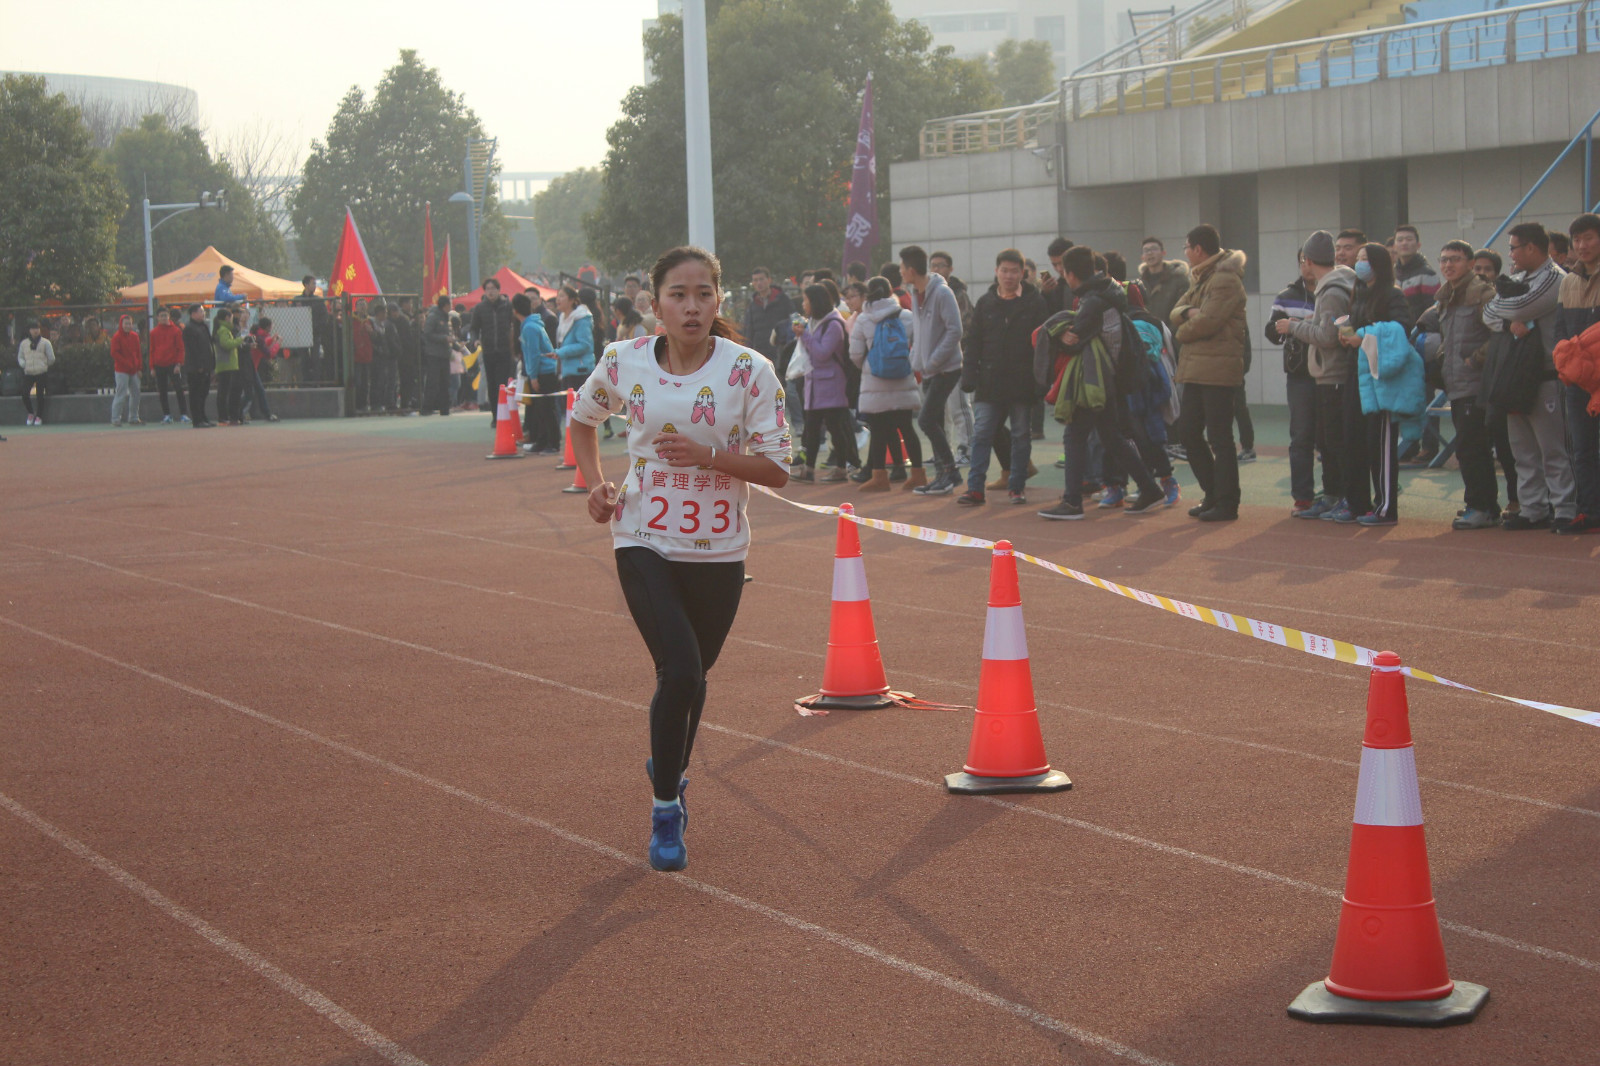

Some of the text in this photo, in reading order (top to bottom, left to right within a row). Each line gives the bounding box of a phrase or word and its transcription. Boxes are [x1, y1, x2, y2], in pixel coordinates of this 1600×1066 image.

[651, 469, 732, 492] 管理学院
[647, 495, 731, 534] 233
